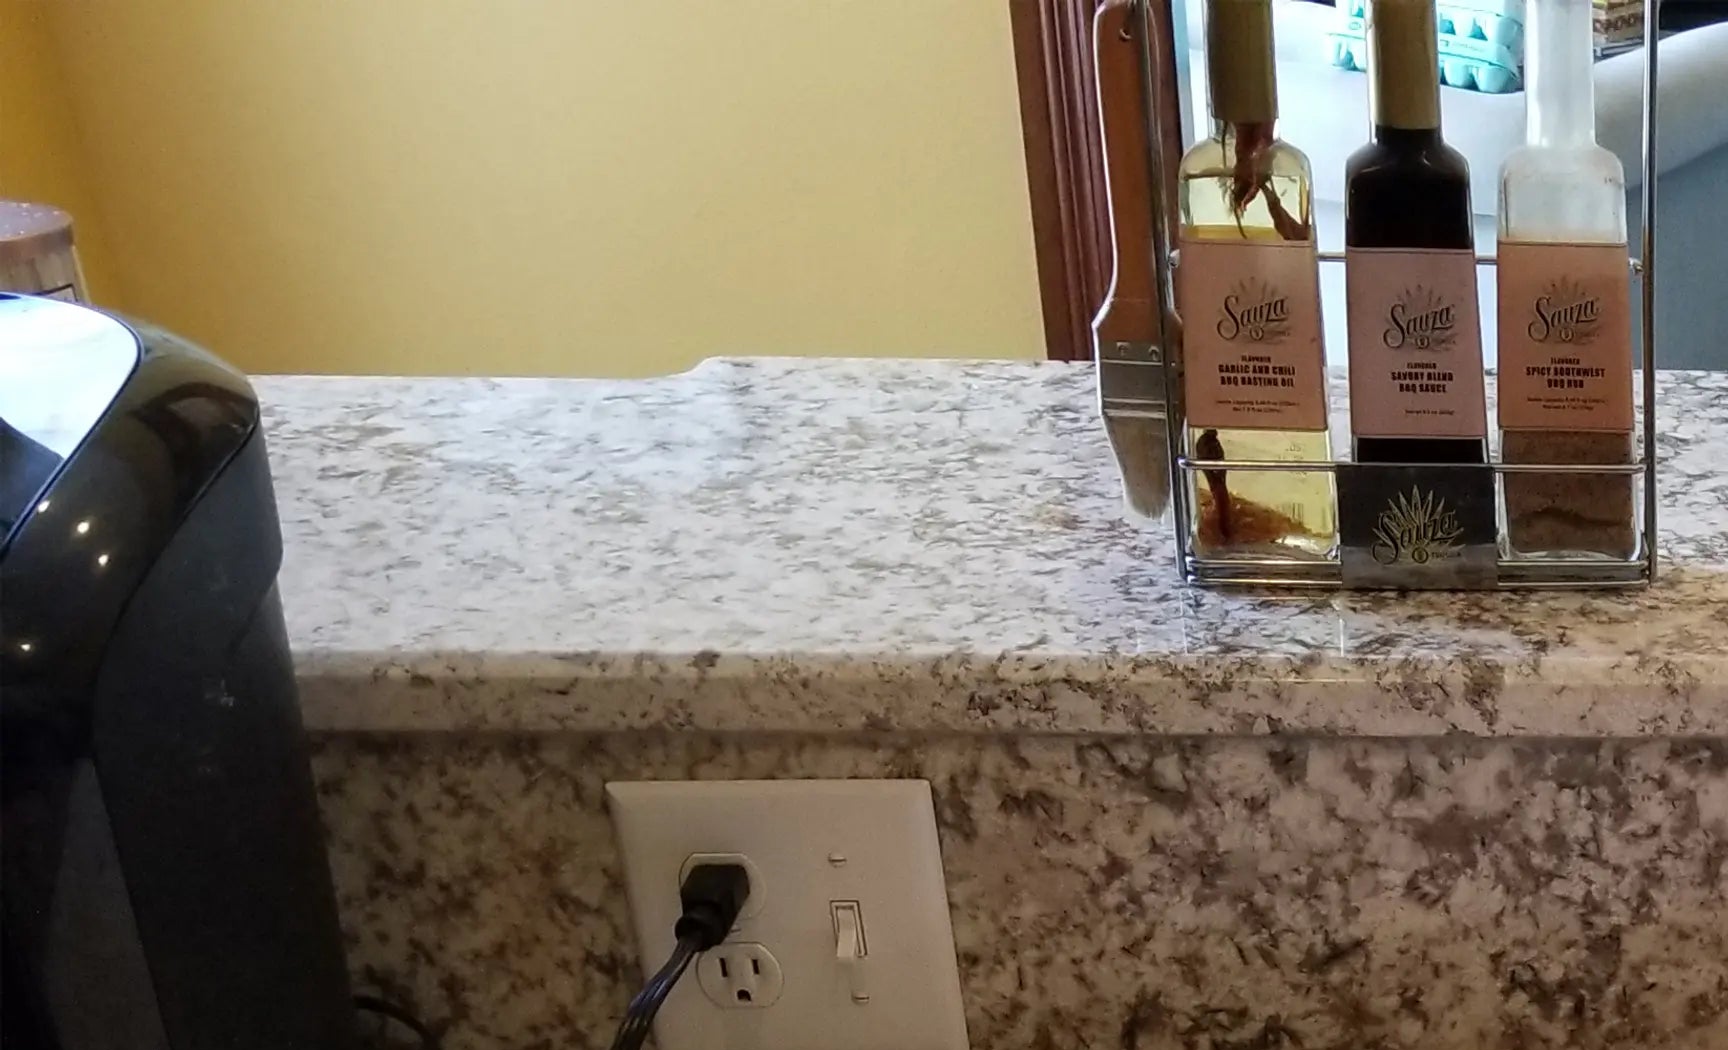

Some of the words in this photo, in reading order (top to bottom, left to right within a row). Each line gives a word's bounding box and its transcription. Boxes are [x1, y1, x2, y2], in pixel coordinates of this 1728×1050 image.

[1216, 295, 1289, 341] Sauza
[1528, 297, 1600, 342] Sauza
[1383, 304, 1455, 349] Sauza
[1218, 364, 1250, 374] GARLIC
[1252, 365, 1270, 375] AND
[1272, 366, 1296, 377] CHILI
[1391, 371, 1424, 381] SAVORY
[1426, 372, 1454, 382] BLEND
[1526, 366, 1551, 376] SPICY
[1553, 367, 1606, 378] SOUTHWEST
[1220, 376, 1239, 387] BBQ
[1241, 376, 1279, 387] BASTING
[1281, 378, 1295, 388] OIL
[1399, 383, 1417, 393] BBQ
[1419, 383, 1447, 393] SAUCE
[1547, 378, 1565, 389] BBQ
[1567, 379, 1584, 389] RUB
[1371, 510, 1460, 565] Sauza
